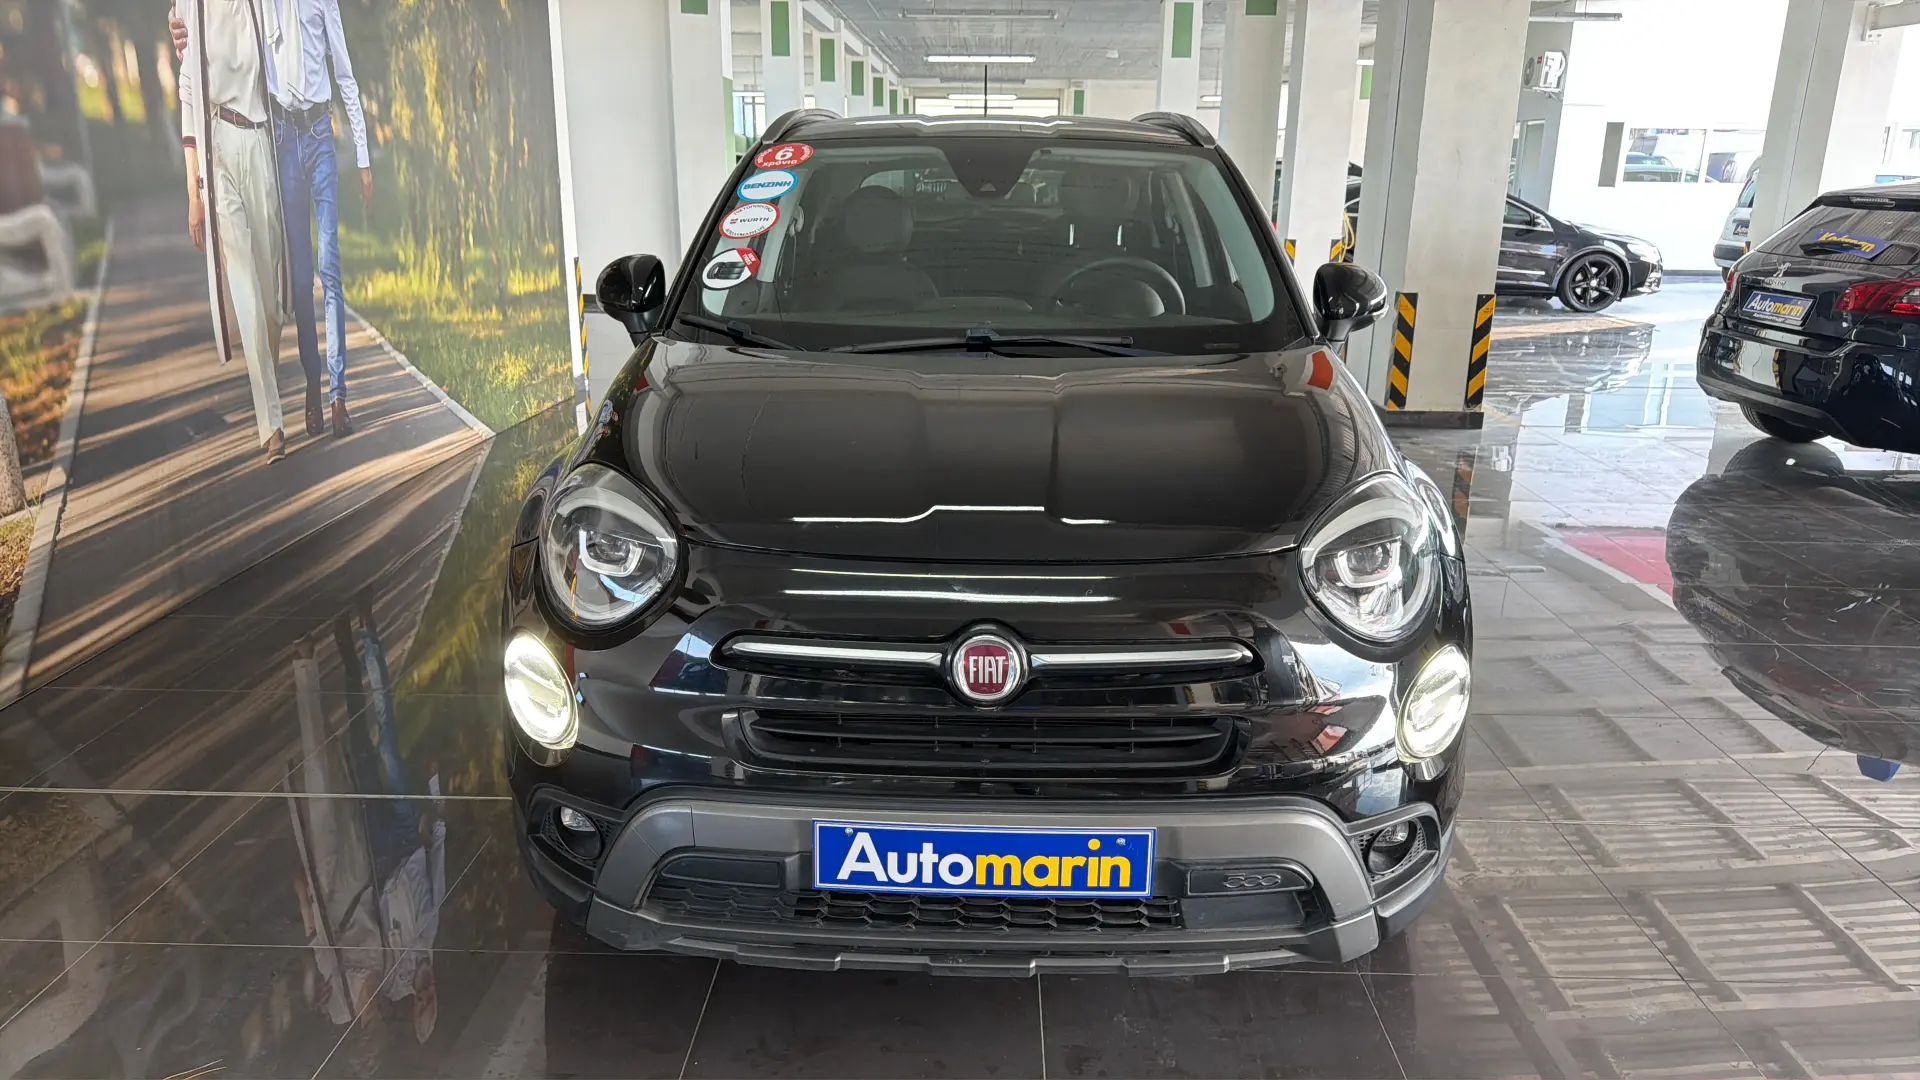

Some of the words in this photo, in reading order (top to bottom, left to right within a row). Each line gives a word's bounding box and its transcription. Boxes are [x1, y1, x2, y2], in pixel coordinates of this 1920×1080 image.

[775, 148, 794, 161] 6
[1747, 293, 1804, 317] Automarin
[969, 656, 1006, 684] FIAT
[837, 831, 1131, 887] Automarin
[1223, 872, 1282, 889] 500
